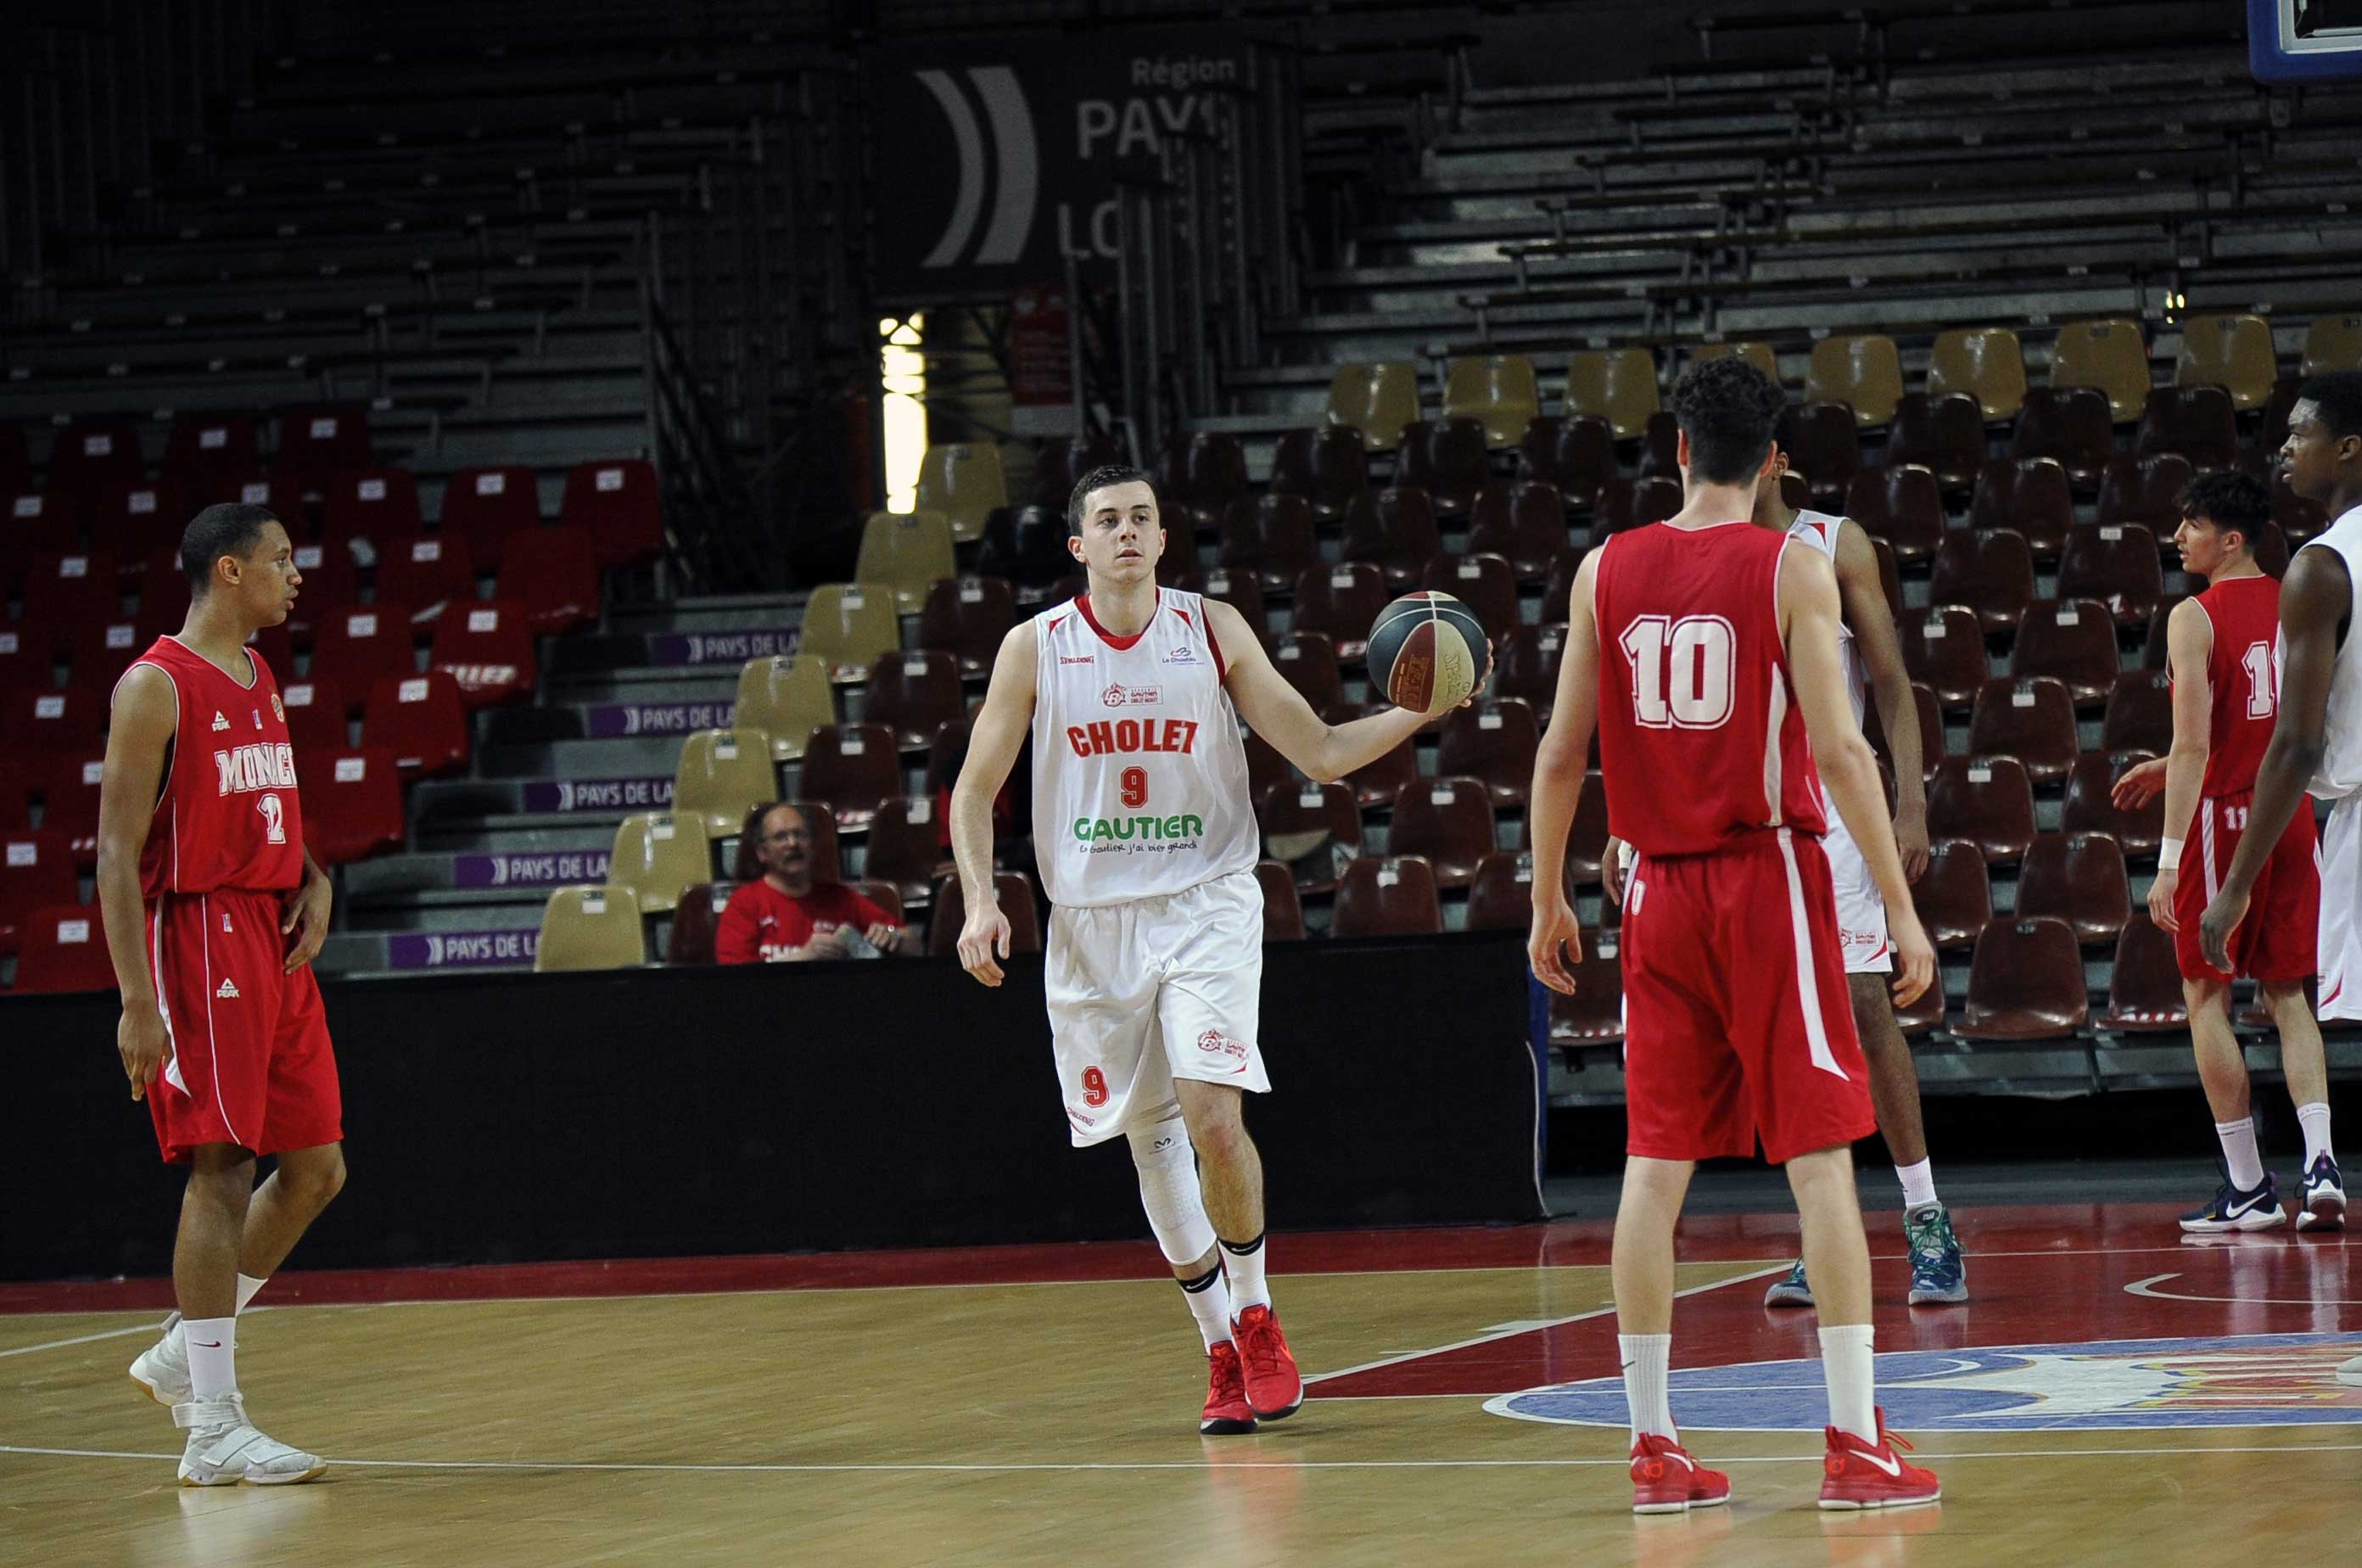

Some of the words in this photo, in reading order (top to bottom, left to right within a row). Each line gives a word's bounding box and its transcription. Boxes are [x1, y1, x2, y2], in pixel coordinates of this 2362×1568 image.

[1131, 56, 1235, 91] Région
[705, 636, 744, 658] PAYS
[752, 634, 775, 657] DE
[1618, 614, 1737, 730] 10
[643, 706, 686, 730] PAYS
[690, 704, 713, 726] DE
[1066, 718, 1199, 758] CHOLET
[577, 782, 621, 806] PAYS
[624, 781, 649, 804] DE
[1121, 766, 1148, 809] 9
[257, 793, 286, 844] 12
[1074, 815, 1203, 842] GAUTIER
[1167, 840, 1198, 854] grandi
[511, 857, 557, 880] PAYS
[558, 856, 582, 879] DE
[585, 854, 608, 877] LA
[445, 936, 492, 960] PAYS
[495, 934, 519, 959] DE
[216, 988, 239, 998] PEAK
[1082, 1066, 1110, 1107] 9
